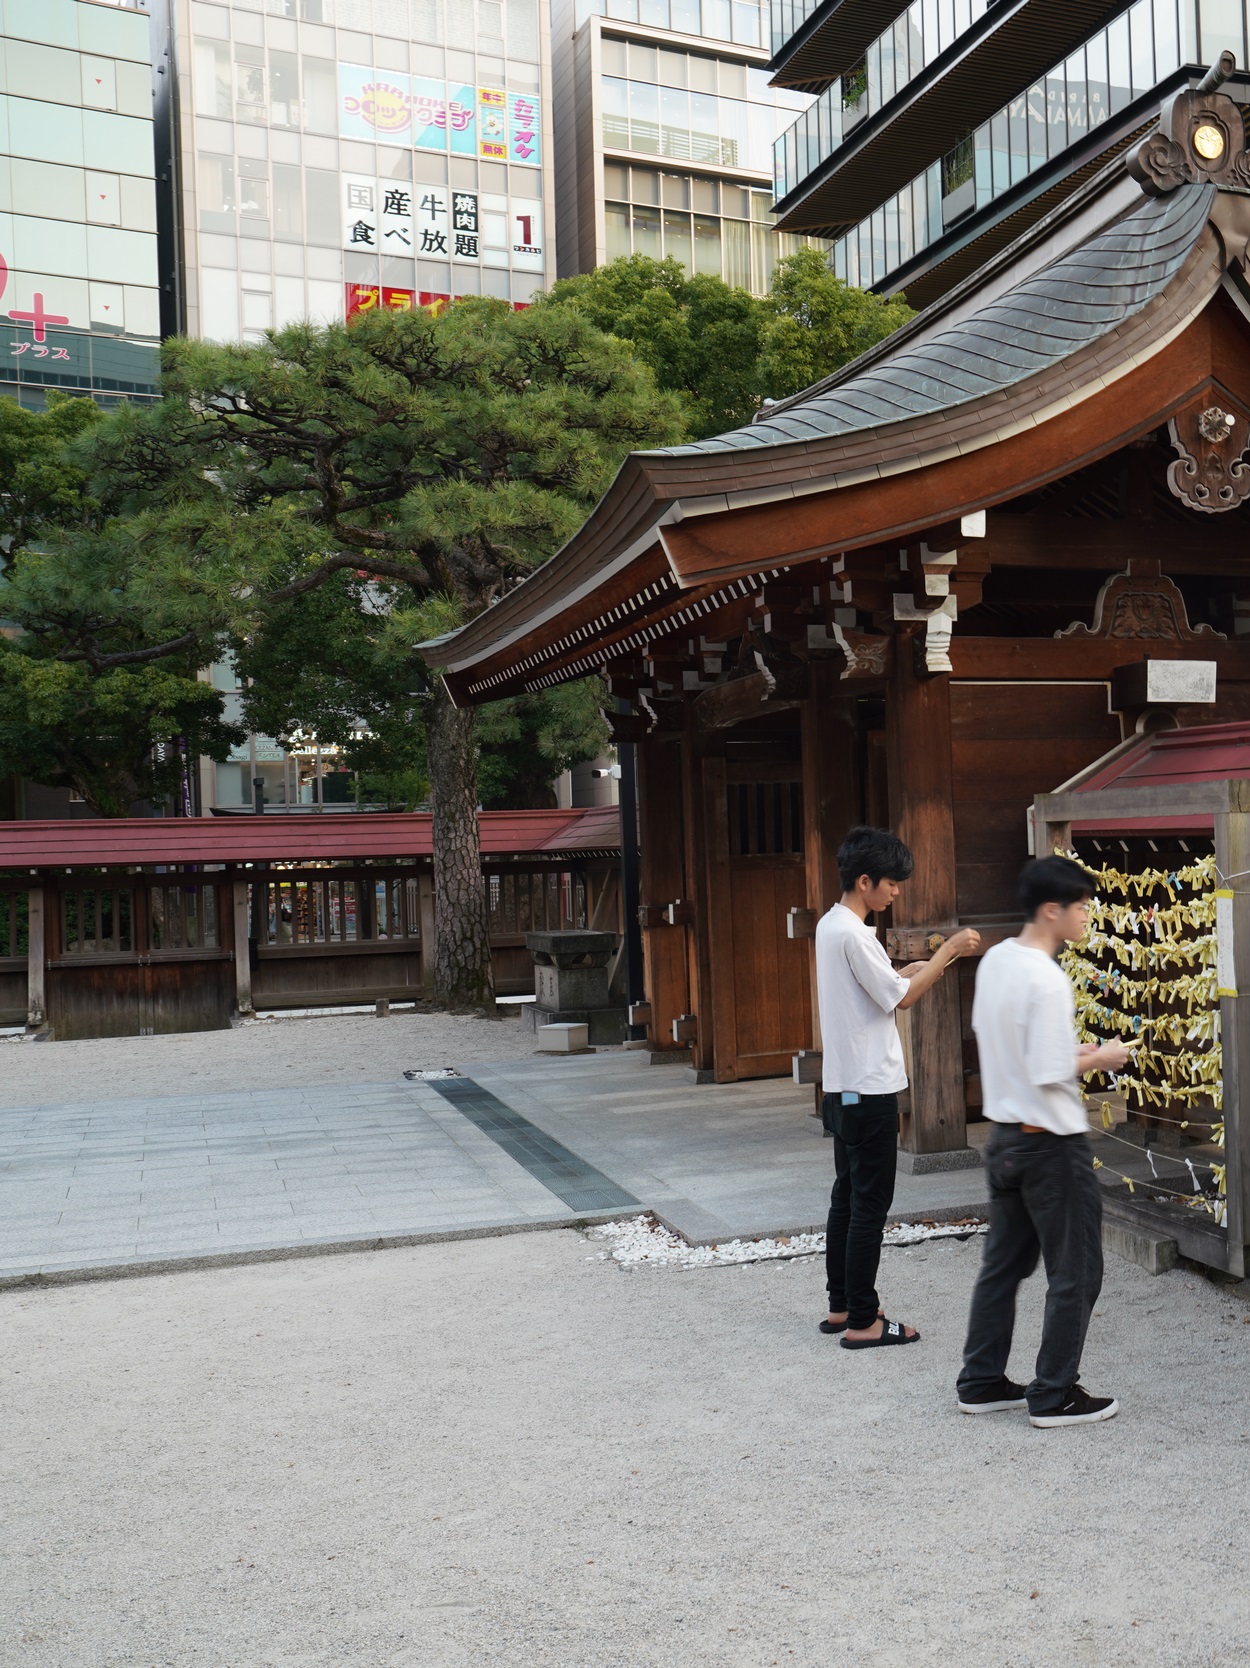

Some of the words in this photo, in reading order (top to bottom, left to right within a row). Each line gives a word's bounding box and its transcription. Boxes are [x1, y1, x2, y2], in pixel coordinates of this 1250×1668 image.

[344, 96, 474, 133] コロッケクラブ
[361, 82, 462, 112] KARAOKE
[514, 99, 535, 160] カラオケ
[483, 144, 504, 156] 無休
[347, 183, 448, 221] 国産牛
[454, 194, 476, 231] 焼肉
[350, 219, 480, 259] 食べ放題
[9, 341, 71, 361] プラス
